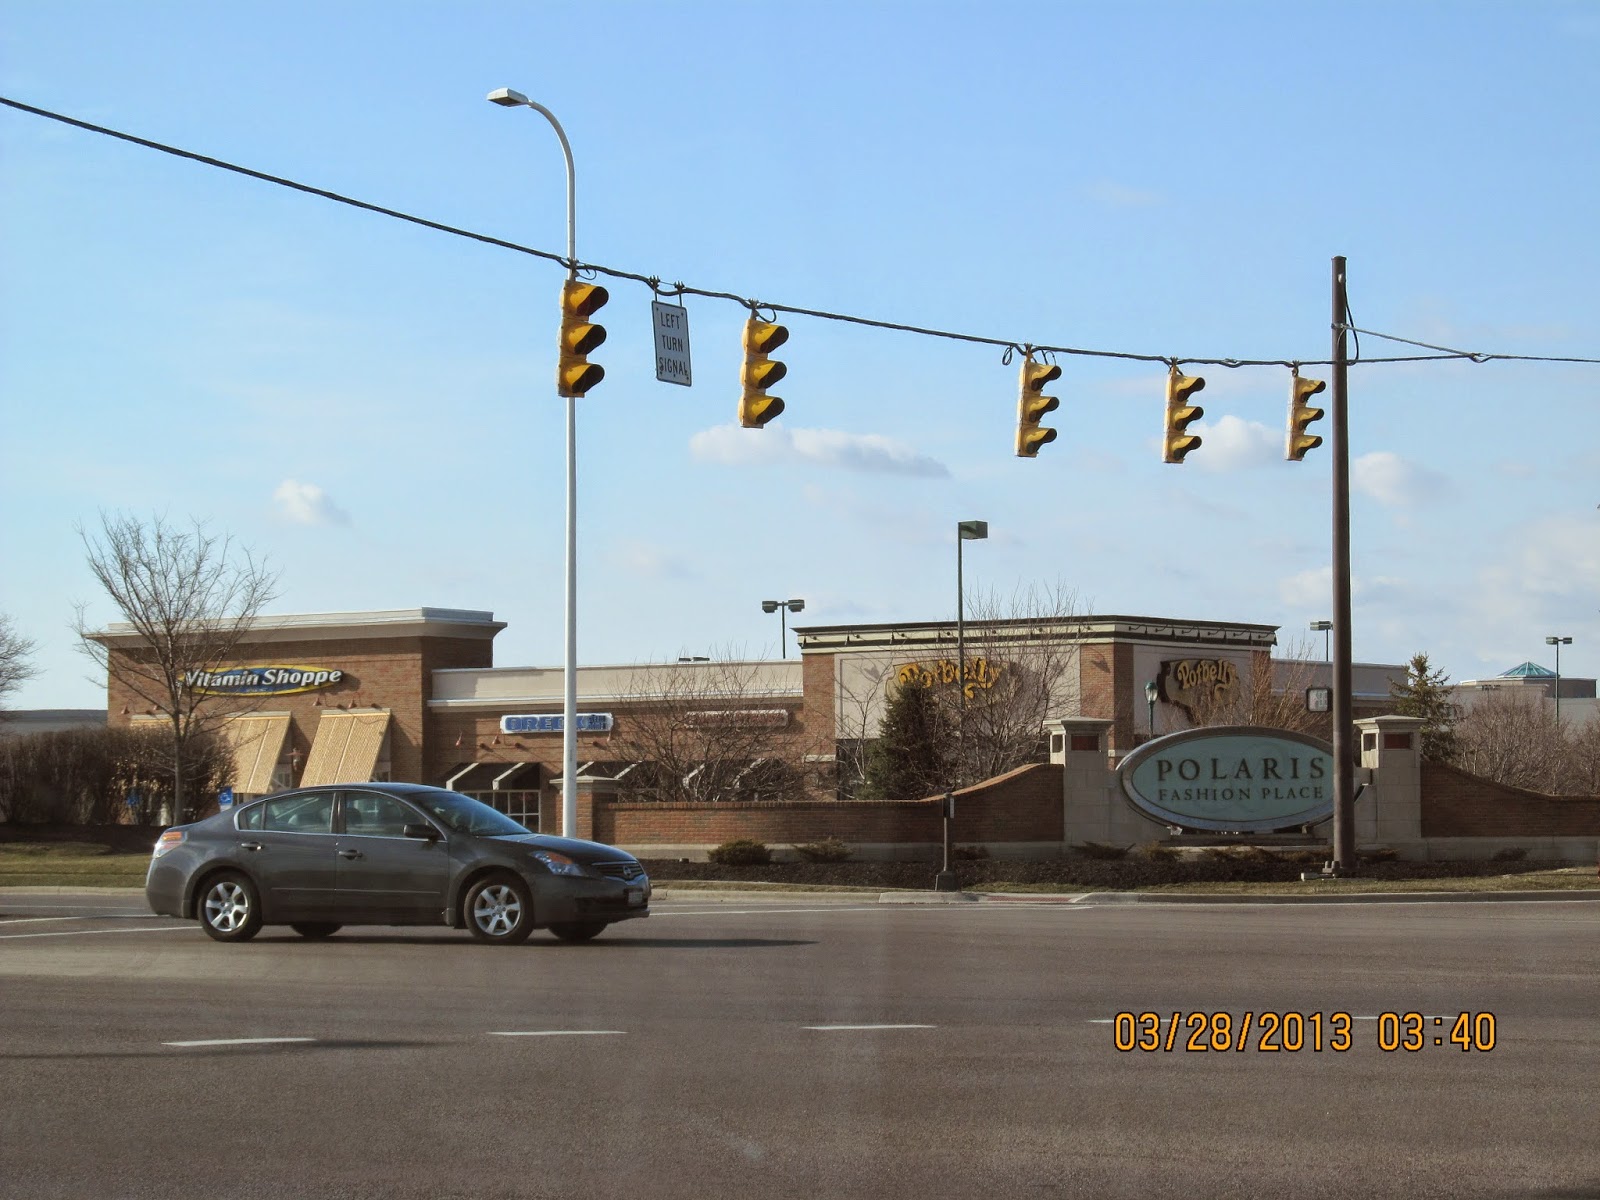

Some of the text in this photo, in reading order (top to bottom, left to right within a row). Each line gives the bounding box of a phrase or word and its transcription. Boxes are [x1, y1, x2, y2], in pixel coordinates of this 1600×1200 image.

[660, 312, 680, 330] LEFT
[662, 335, 683, 352] TURN
[659, 357, 688, 376] SIGNAL
[185, 669, 343, 687] Vitamin Shoppe
[1178, 659, 1237, 701] Potbelly
[1155, 757, 1325, 782] POLARIS
[1158, 786, 1324, 801] FASHION PLACE
